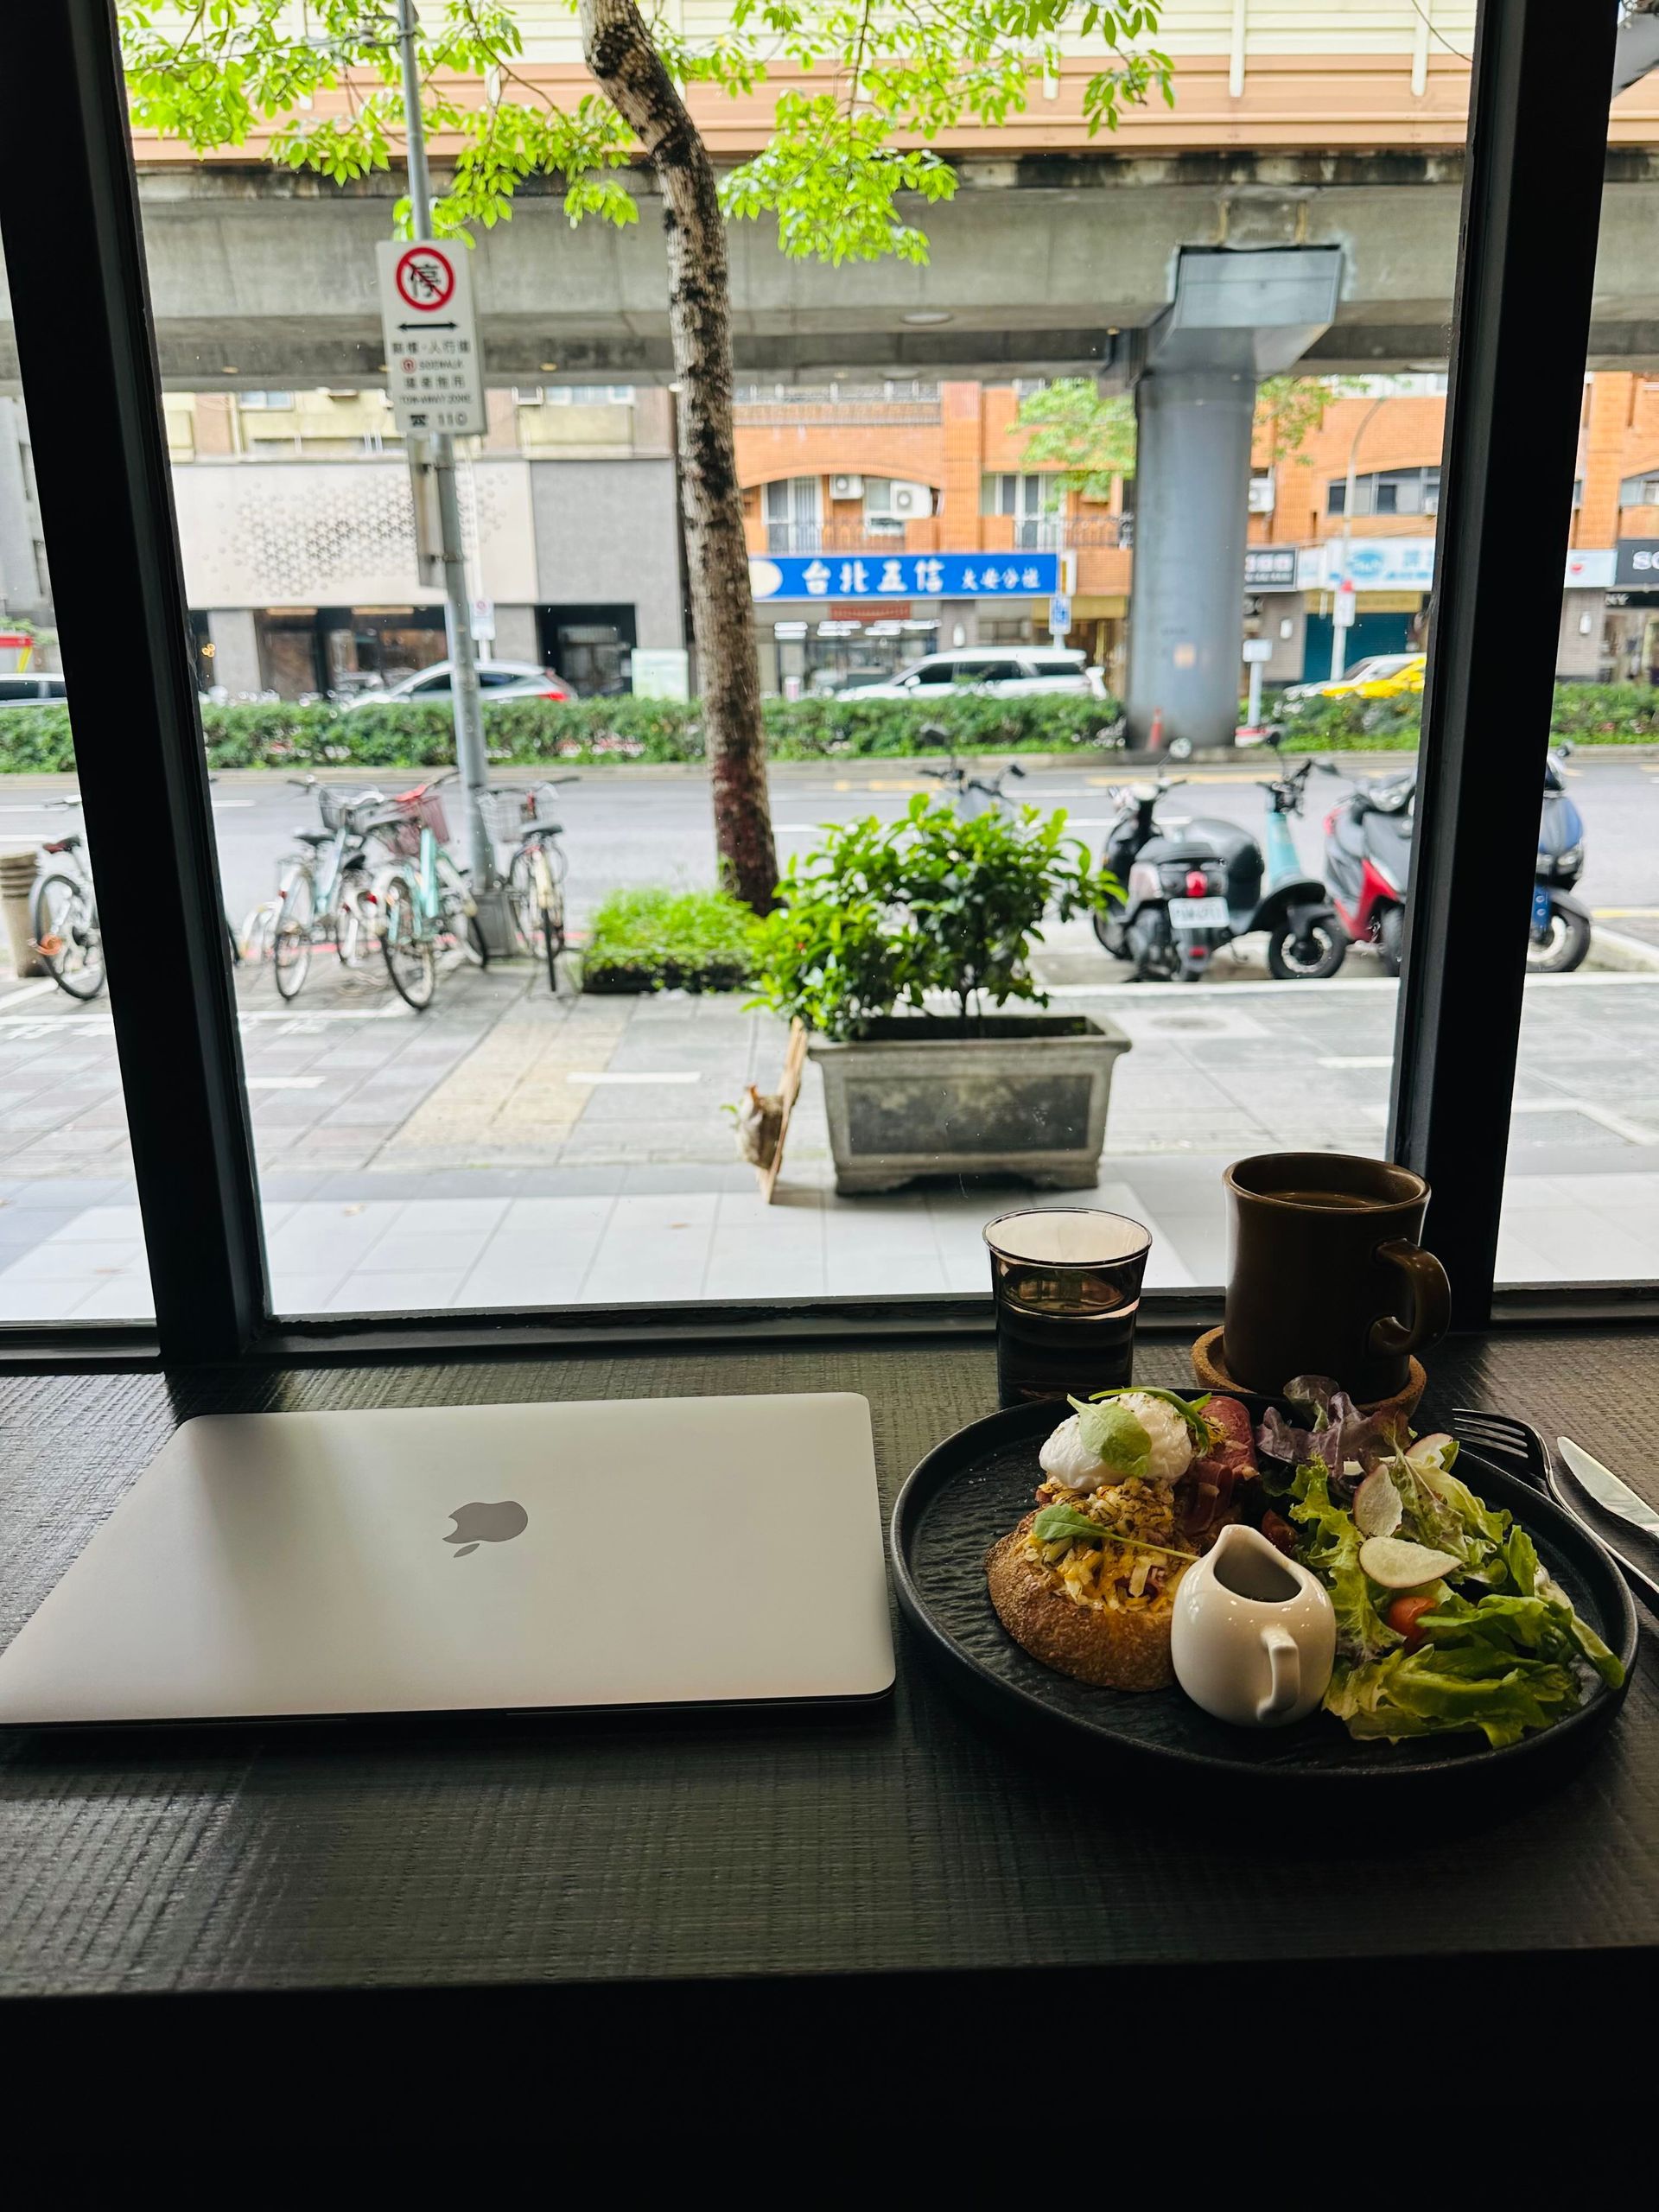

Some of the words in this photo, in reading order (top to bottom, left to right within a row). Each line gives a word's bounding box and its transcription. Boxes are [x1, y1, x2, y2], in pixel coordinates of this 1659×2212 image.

[438, 411, 467, 426] 110
[802, 558, 945, 594] 台北五信
